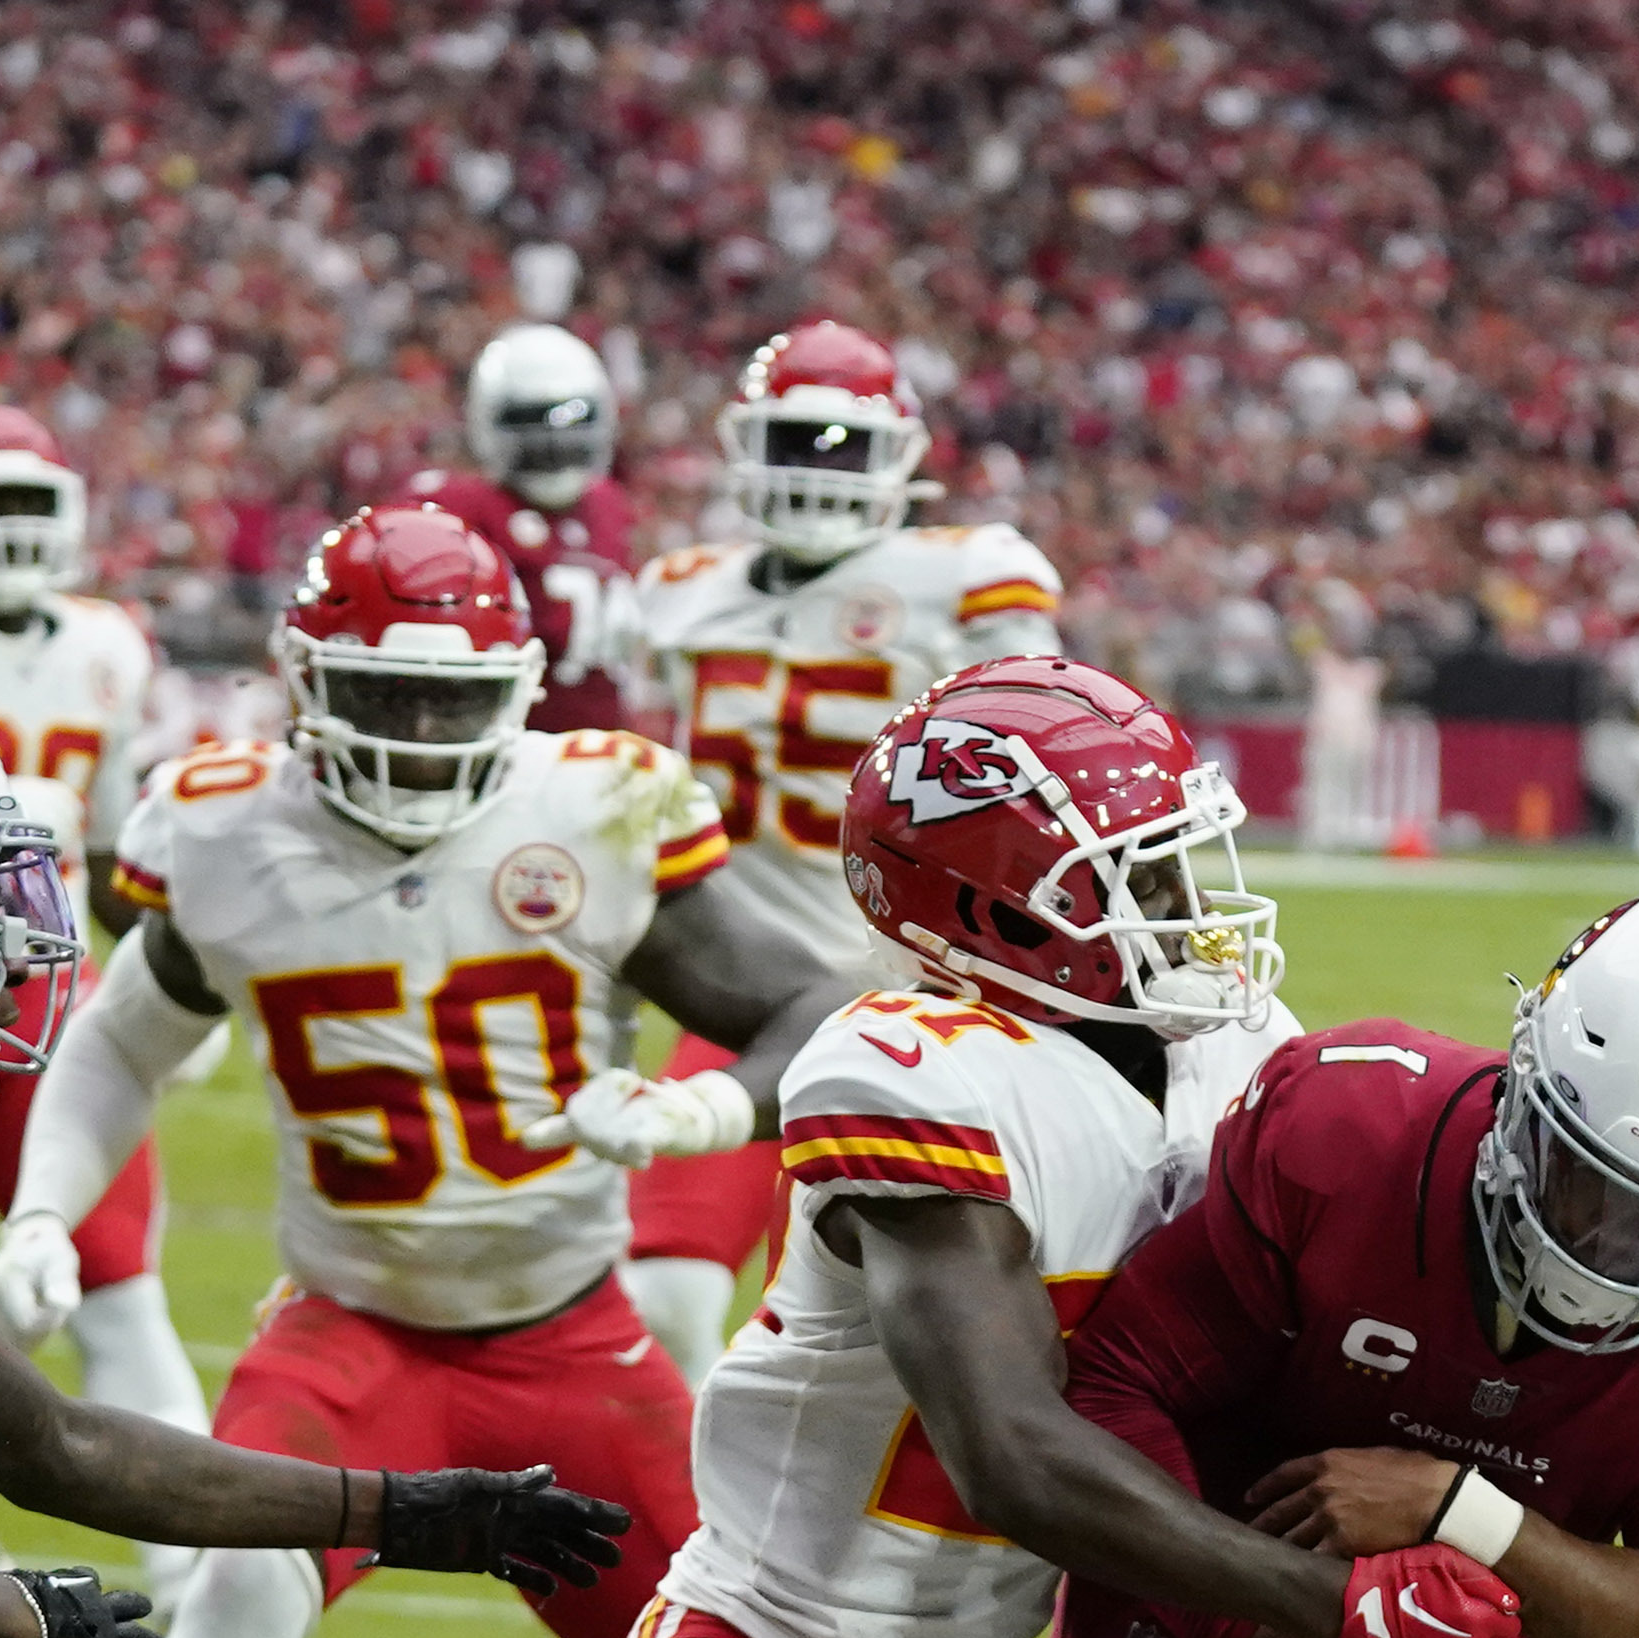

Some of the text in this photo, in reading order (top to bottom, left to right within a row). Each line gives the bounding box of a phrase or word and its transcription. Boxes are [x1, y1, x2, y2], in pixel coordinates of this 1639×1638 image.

[687, 650, 894, 854] 55
[917, 737, 1021, 799] KC
[248, 948, 590, 1210] 50
[1318, 1043, 1429, 1077] 1
[1341, 1317, 1419, 1373] C
[1388, 1412, 1552, 1472] CARDINALS
